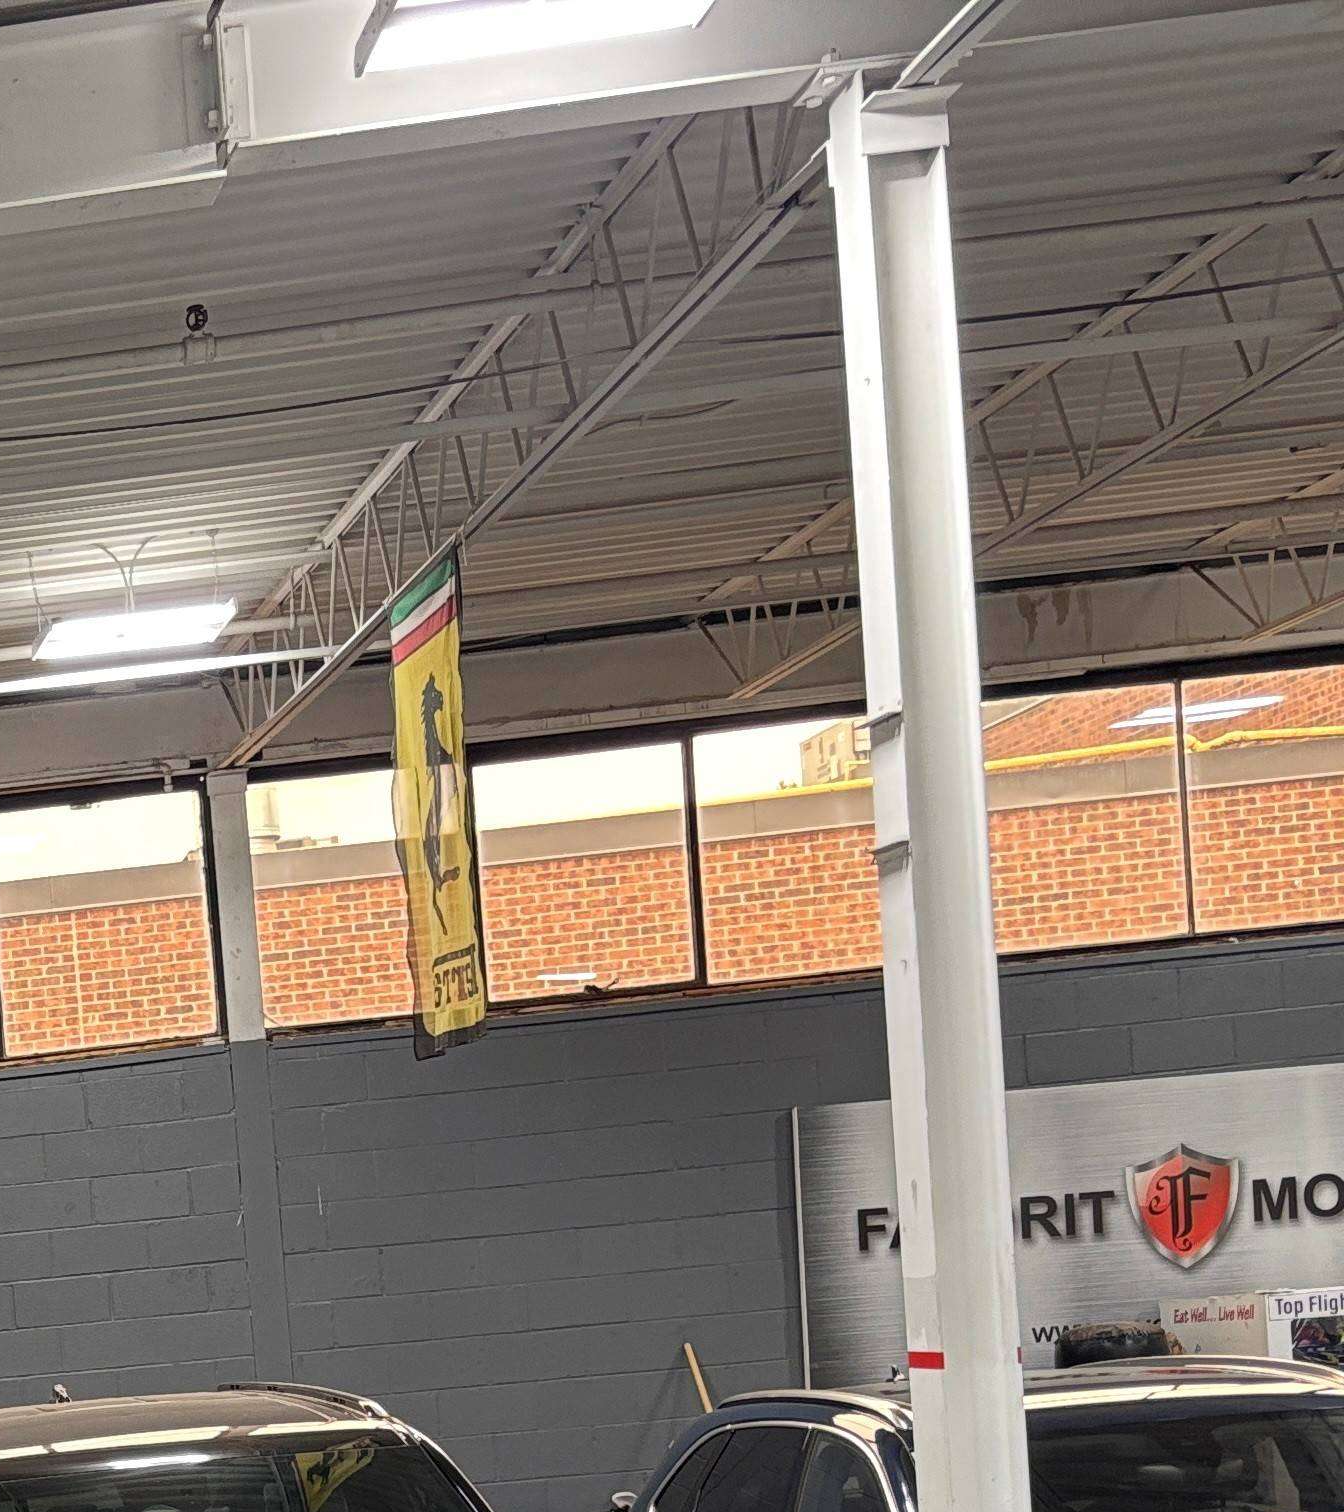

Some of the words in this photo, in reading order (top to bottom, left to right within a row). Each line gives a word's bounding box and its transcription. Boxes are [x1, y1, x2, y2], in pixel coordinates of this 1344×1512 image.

[857, 1190, 1115, 1251] FRIT
[1174, 1308, 1189, 1324] Eat
[1218, 1305, 1235, 1321] Live
[1236, 1304, 1255, 1321] Well
[1274, 1297, 1303, 1318] Top
